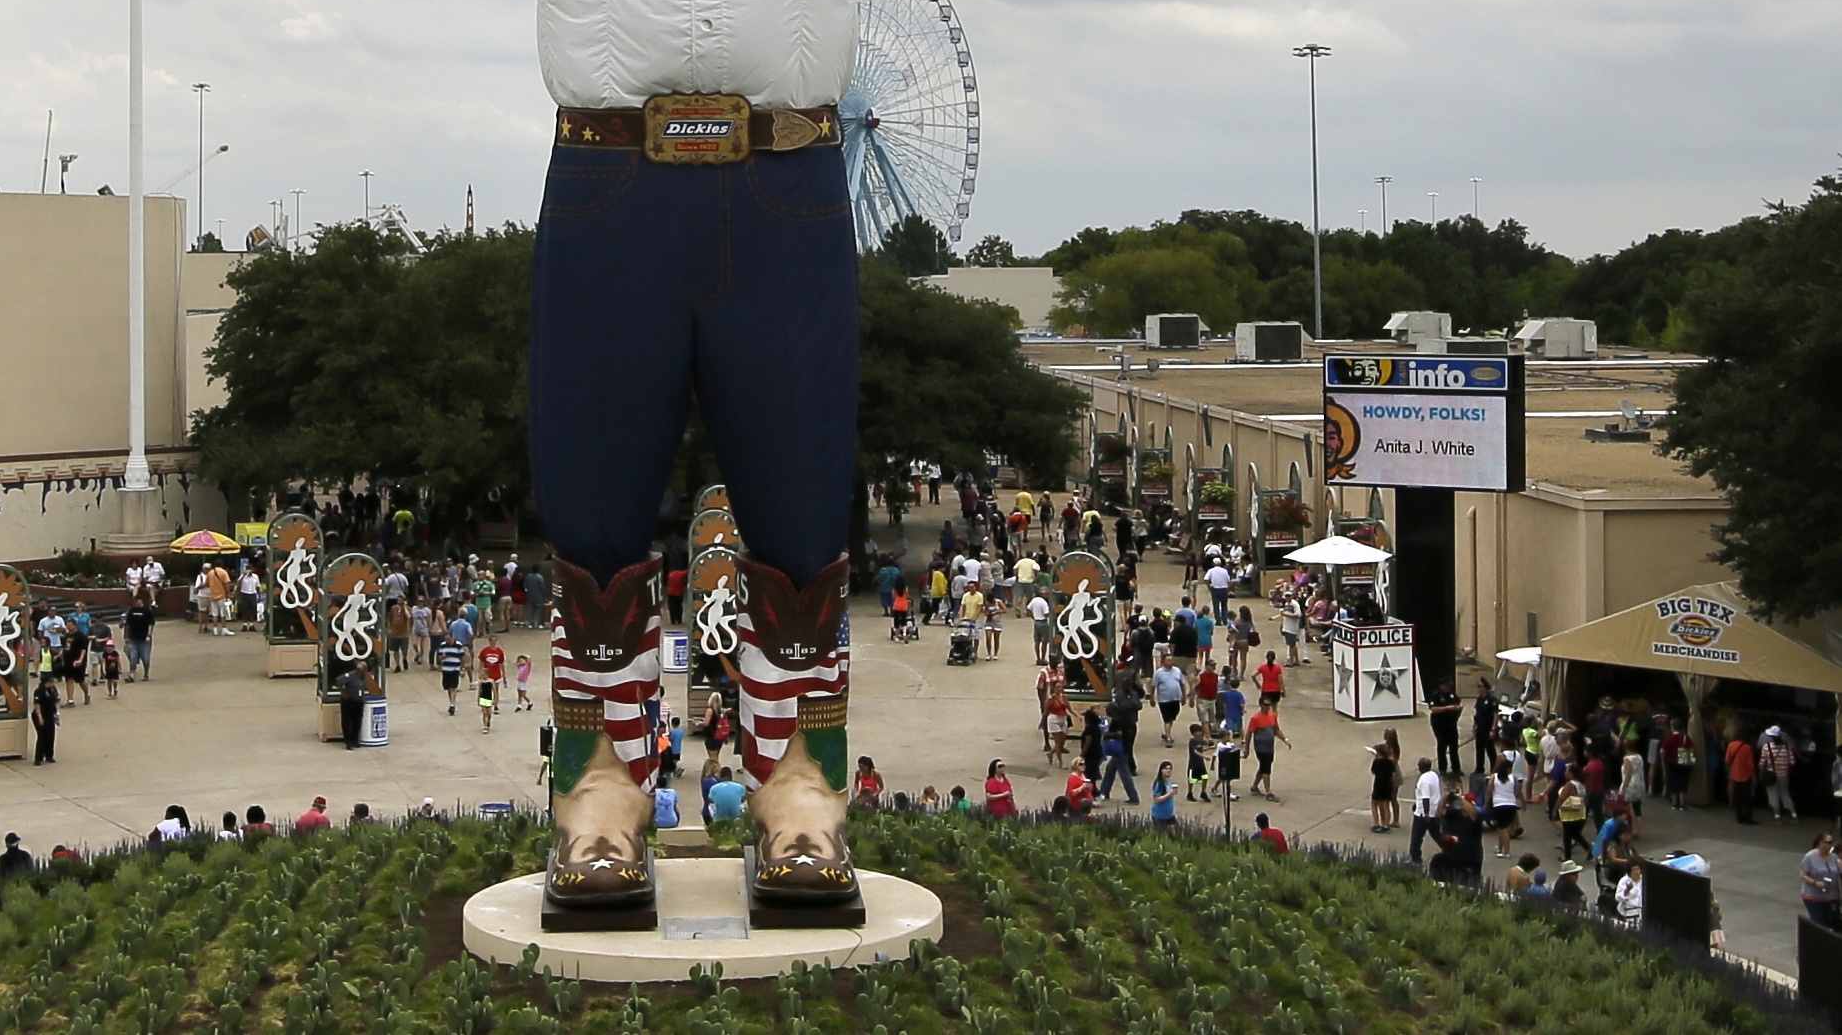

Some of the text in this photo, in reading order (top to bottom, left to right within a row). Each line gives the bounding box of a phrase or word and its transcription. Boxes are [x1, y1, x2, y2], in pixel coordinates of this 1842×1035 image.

[665, 123, 729, 134] Dickies
[1408, 360, 1466, 387] info
[1363, 405, 1486, 421] HOWDY, FOLKS!
[1374, 439, 1475, 455] Anita J. White
[1656, 598, 1735, 625] BIG TEX
[1359, 628, 1411, 644] POLICE
[1678, 625, 1716, 636] Dickies
[1653, 644, 1739, 662] MERCHANDISE
